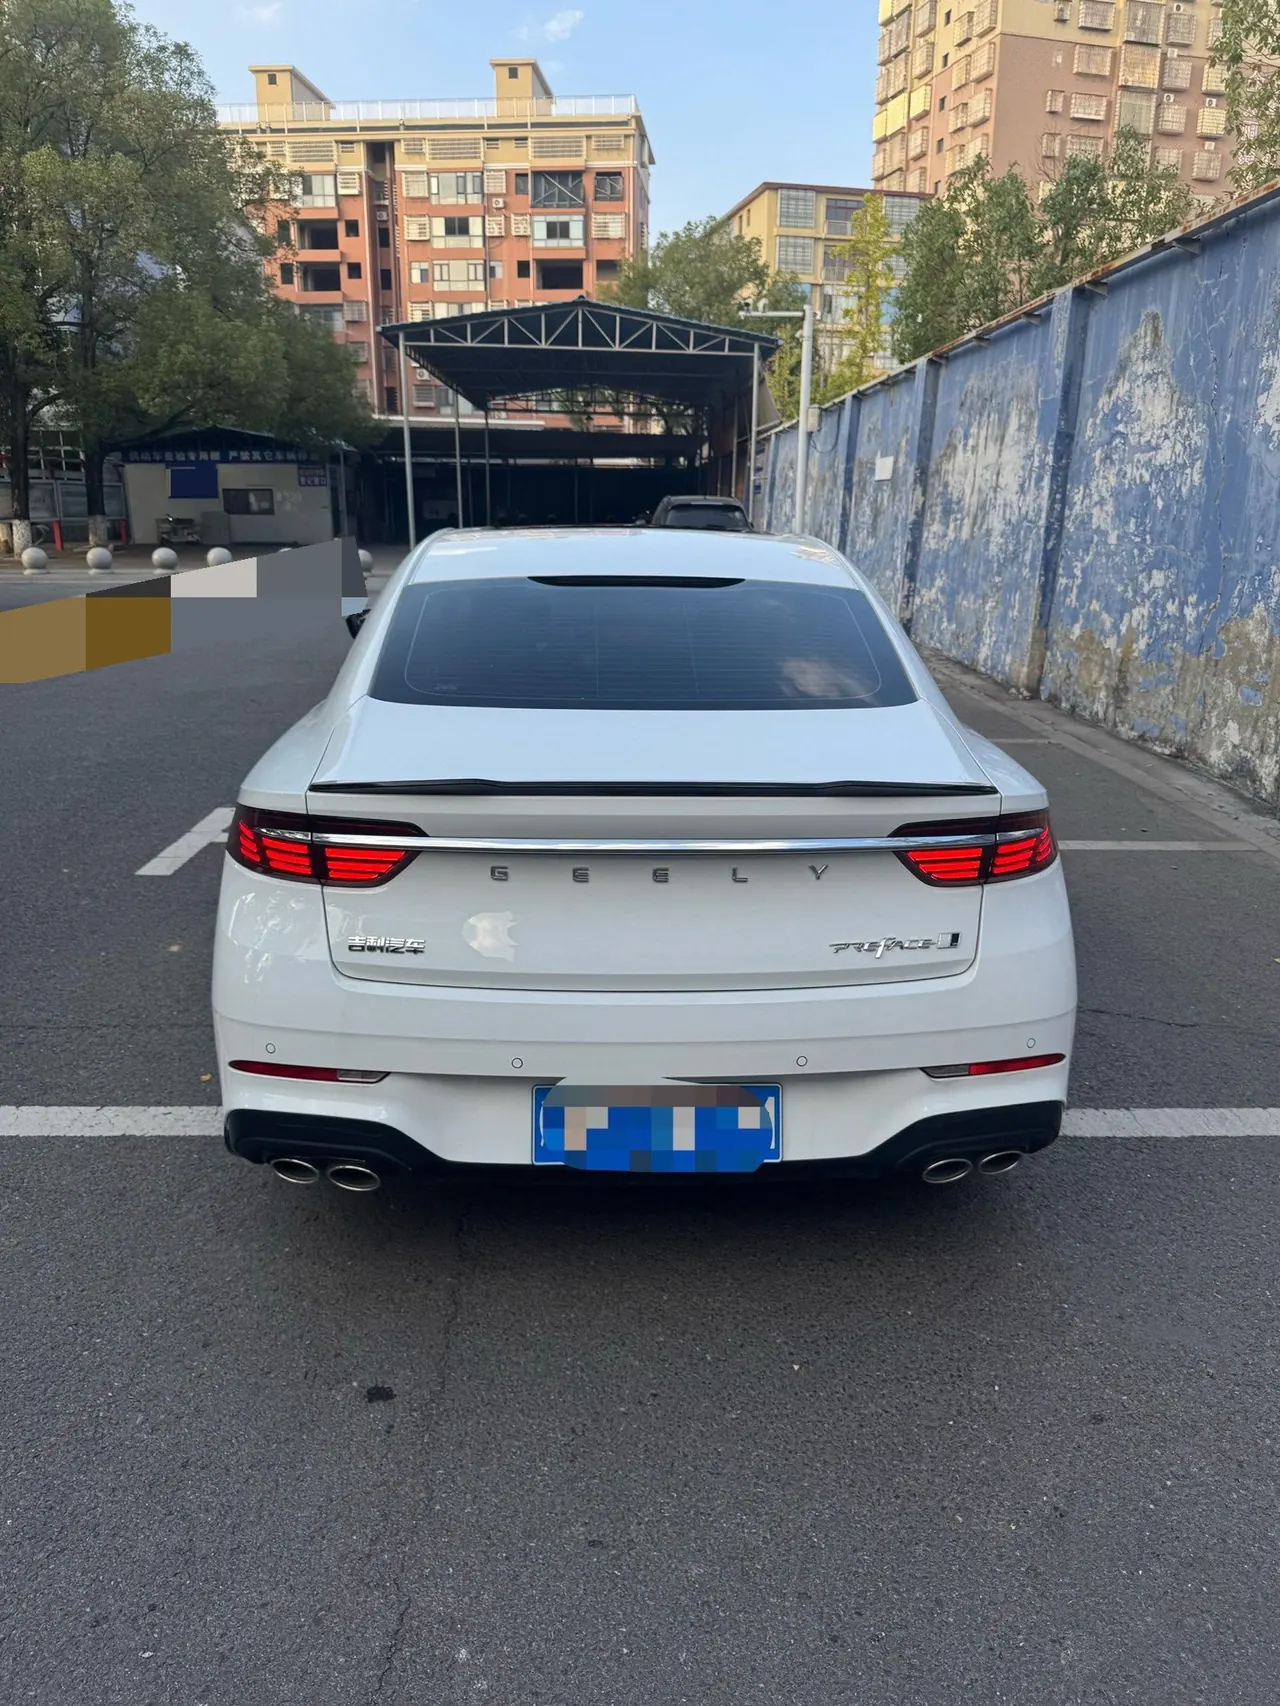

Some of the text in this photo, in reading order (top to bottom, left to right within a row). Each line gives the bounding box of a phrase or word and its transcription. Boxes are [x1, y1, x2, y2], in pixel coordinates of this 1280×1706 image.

[490, 864, 828, 883] GEELY
[348, 936, 426, 955] 吉利汽车
